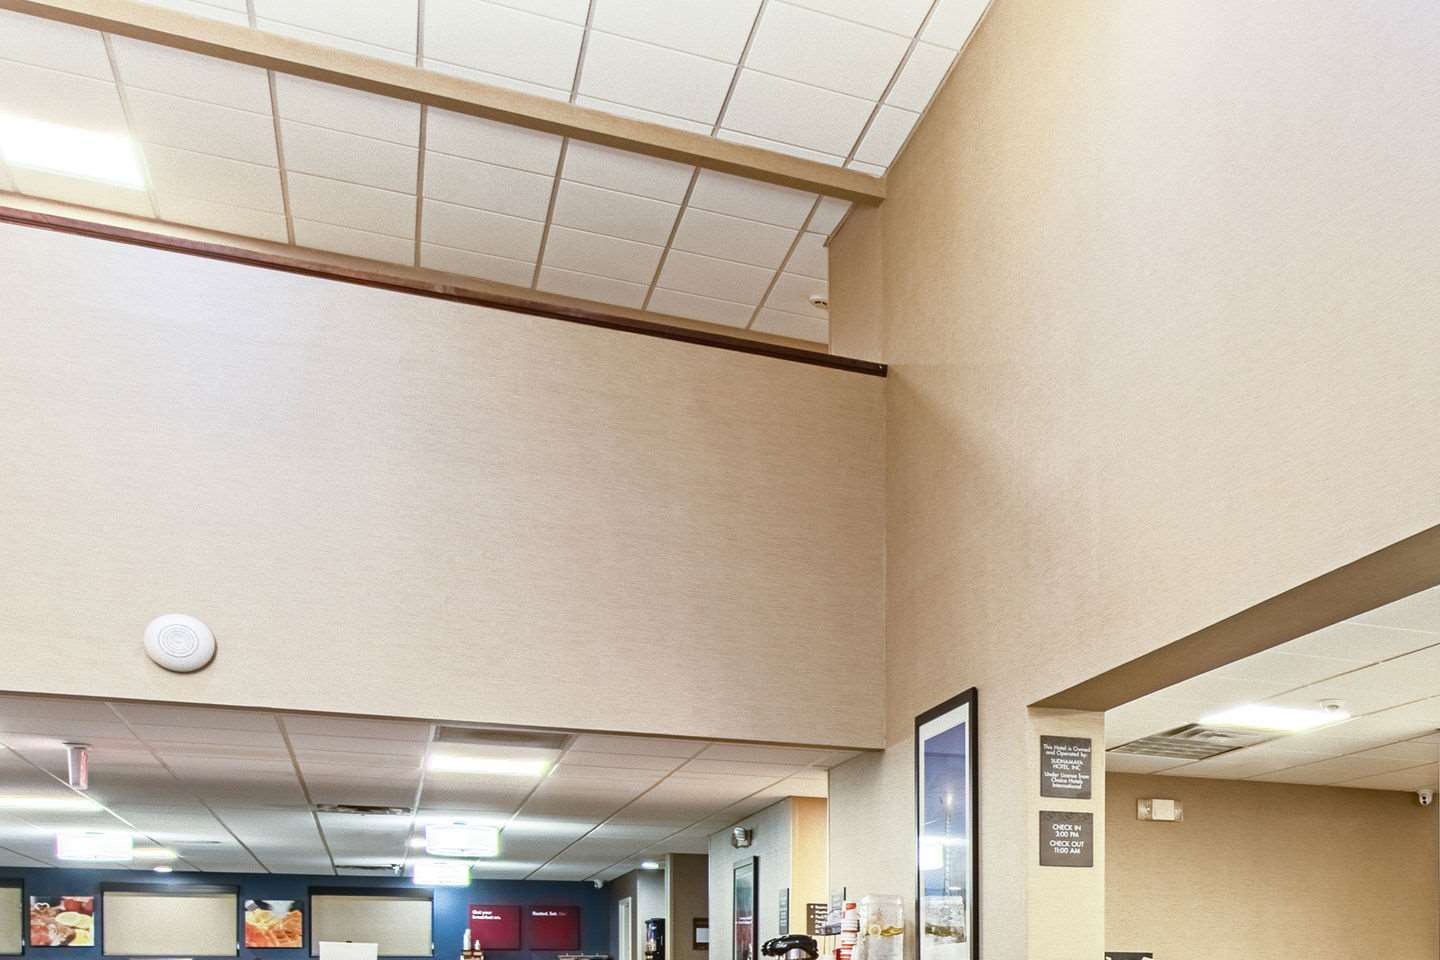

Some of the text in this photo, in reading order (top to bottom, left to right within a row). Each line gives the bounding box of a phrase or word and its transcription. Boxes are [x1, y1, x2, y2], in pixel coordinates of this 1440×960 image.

[1052, 823, 1073, 831] CHECK
[1049, 839, 1084, 848] CHECK OUT
